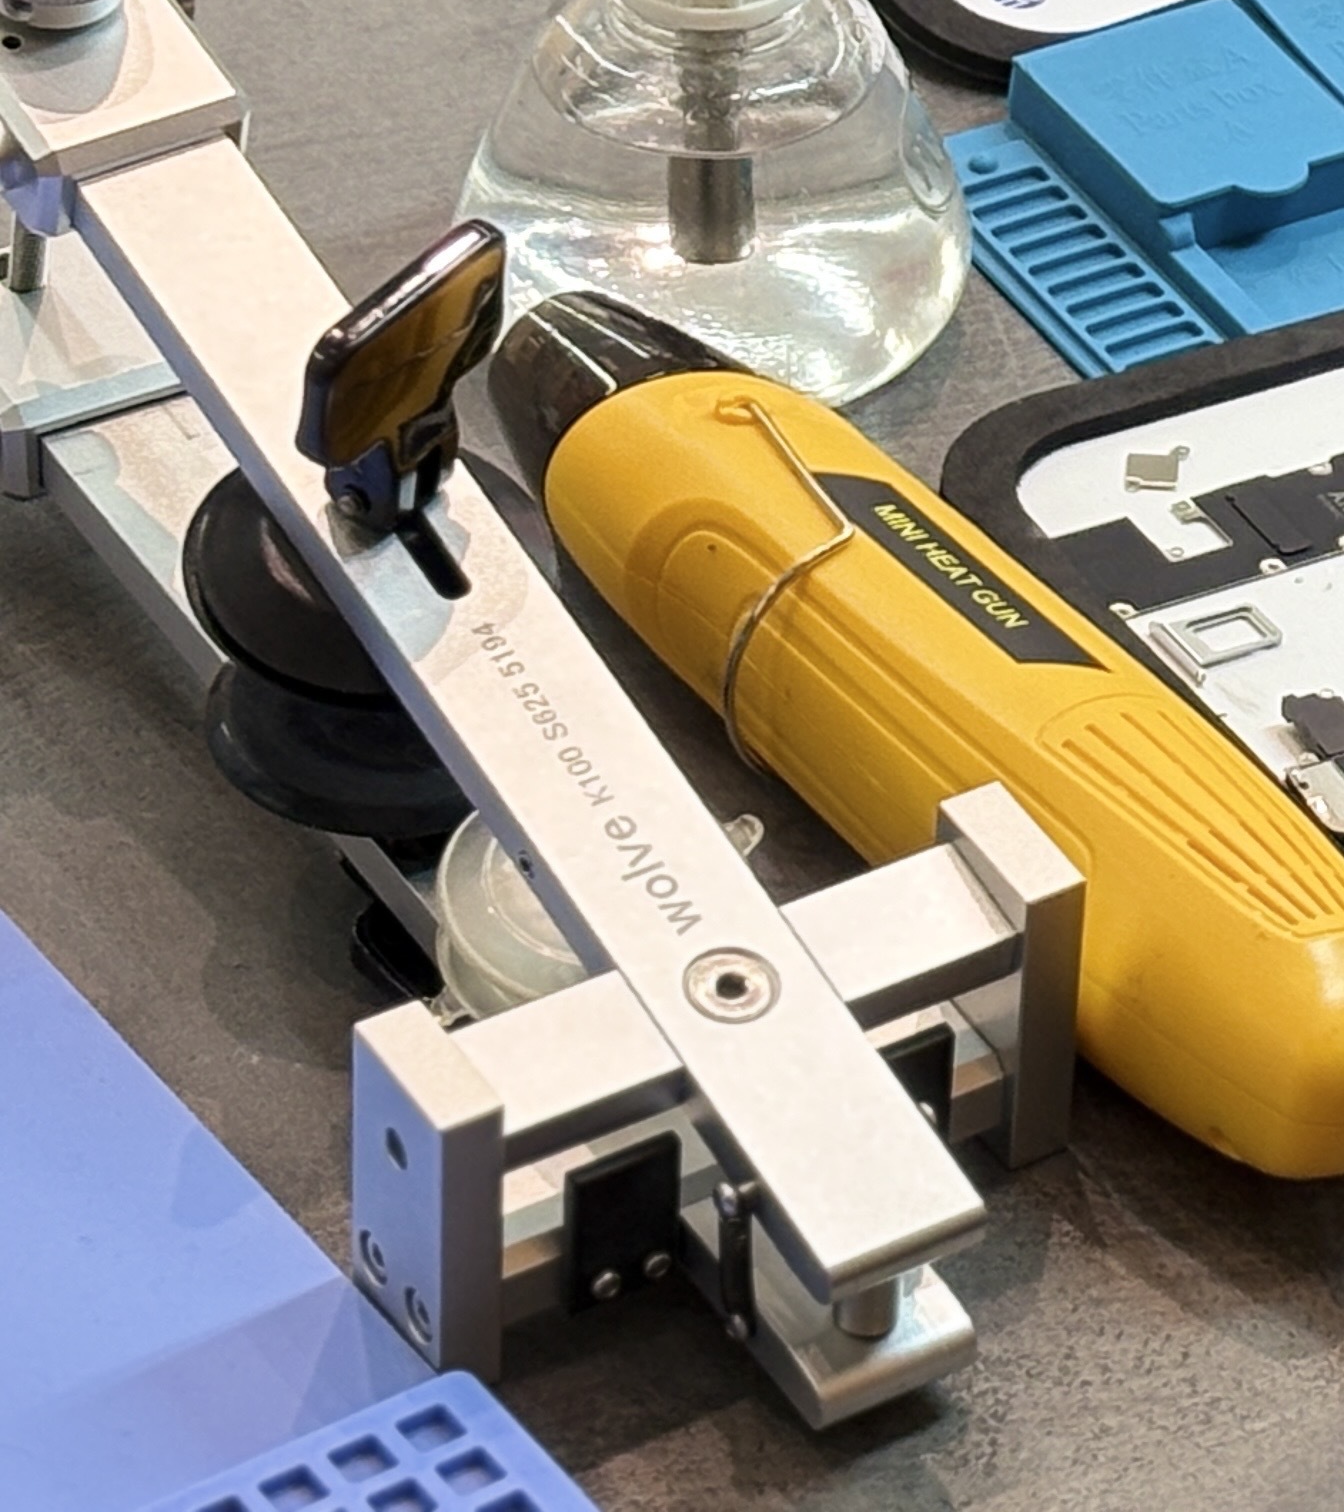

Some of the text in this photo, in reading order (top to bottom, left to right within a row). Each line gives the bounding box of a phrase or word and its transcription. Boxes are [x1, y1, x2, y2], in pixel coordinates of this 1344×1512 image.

[872, 502, 1030, 629] MINI HEAT GUN
[471, 622, 705, 935] wolve K100 S625 5194
